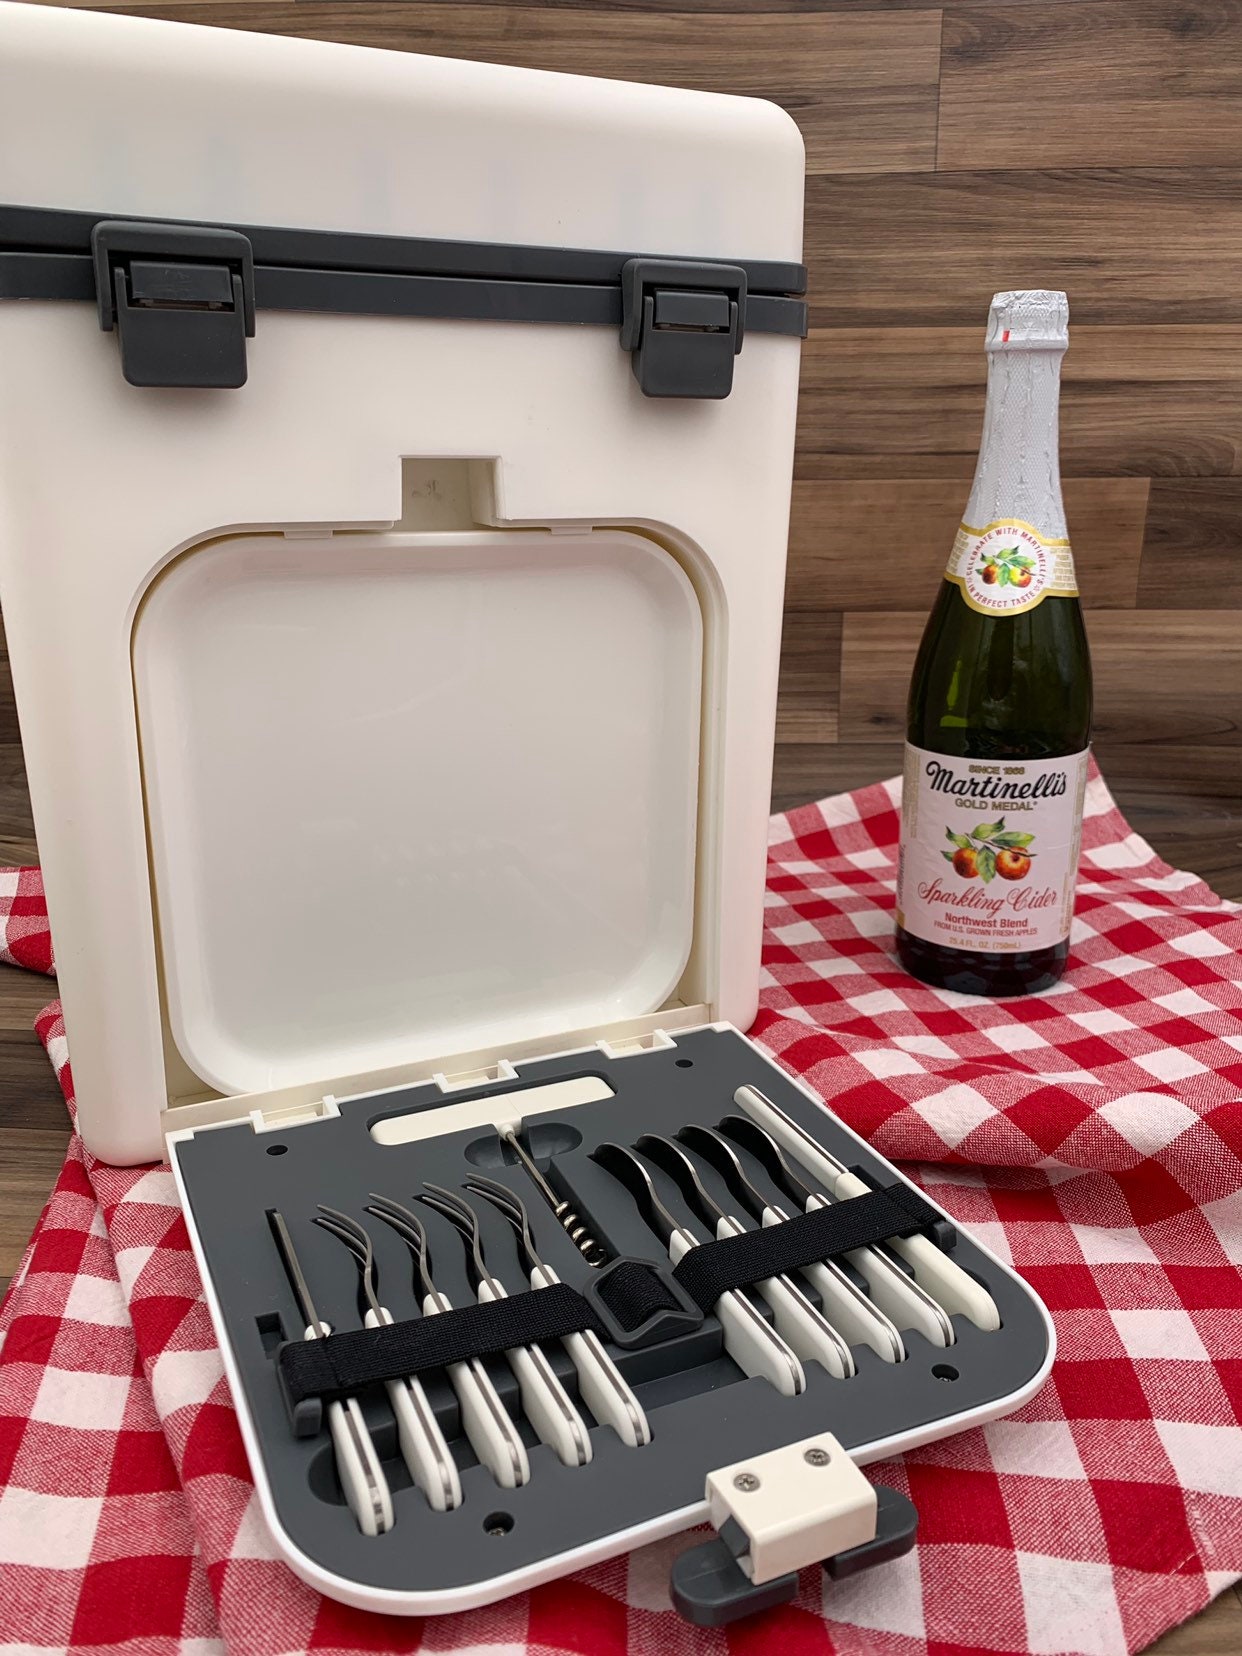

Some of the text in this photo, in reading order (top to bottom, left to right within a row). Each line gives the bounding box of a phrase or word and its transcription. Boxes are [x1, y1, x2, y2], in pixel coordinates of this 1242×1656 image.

[966, 534, 993, 576] CELEBRATE
[995, 527, 1018, 537] WITH
[967, 582, 1035, 608] IN PERFECT TASTE
[925, 760, 1067, 799] Martinelli's
[968, 764, 1000, 775] SINCE
[954, 797, 988, 810] GOLD
[918, 878, 1005, 919] Sparkling
[1007, 886, 1057, 912] Cider
[934, 920, 951, 930] FROM
[966, 927, 991, 936] GROWN
[993, 929, 1014, 937] FRESH
[1015, 927, 1038, 936] APPLES
[945, 912, 1028, 928] Northwest Blend
